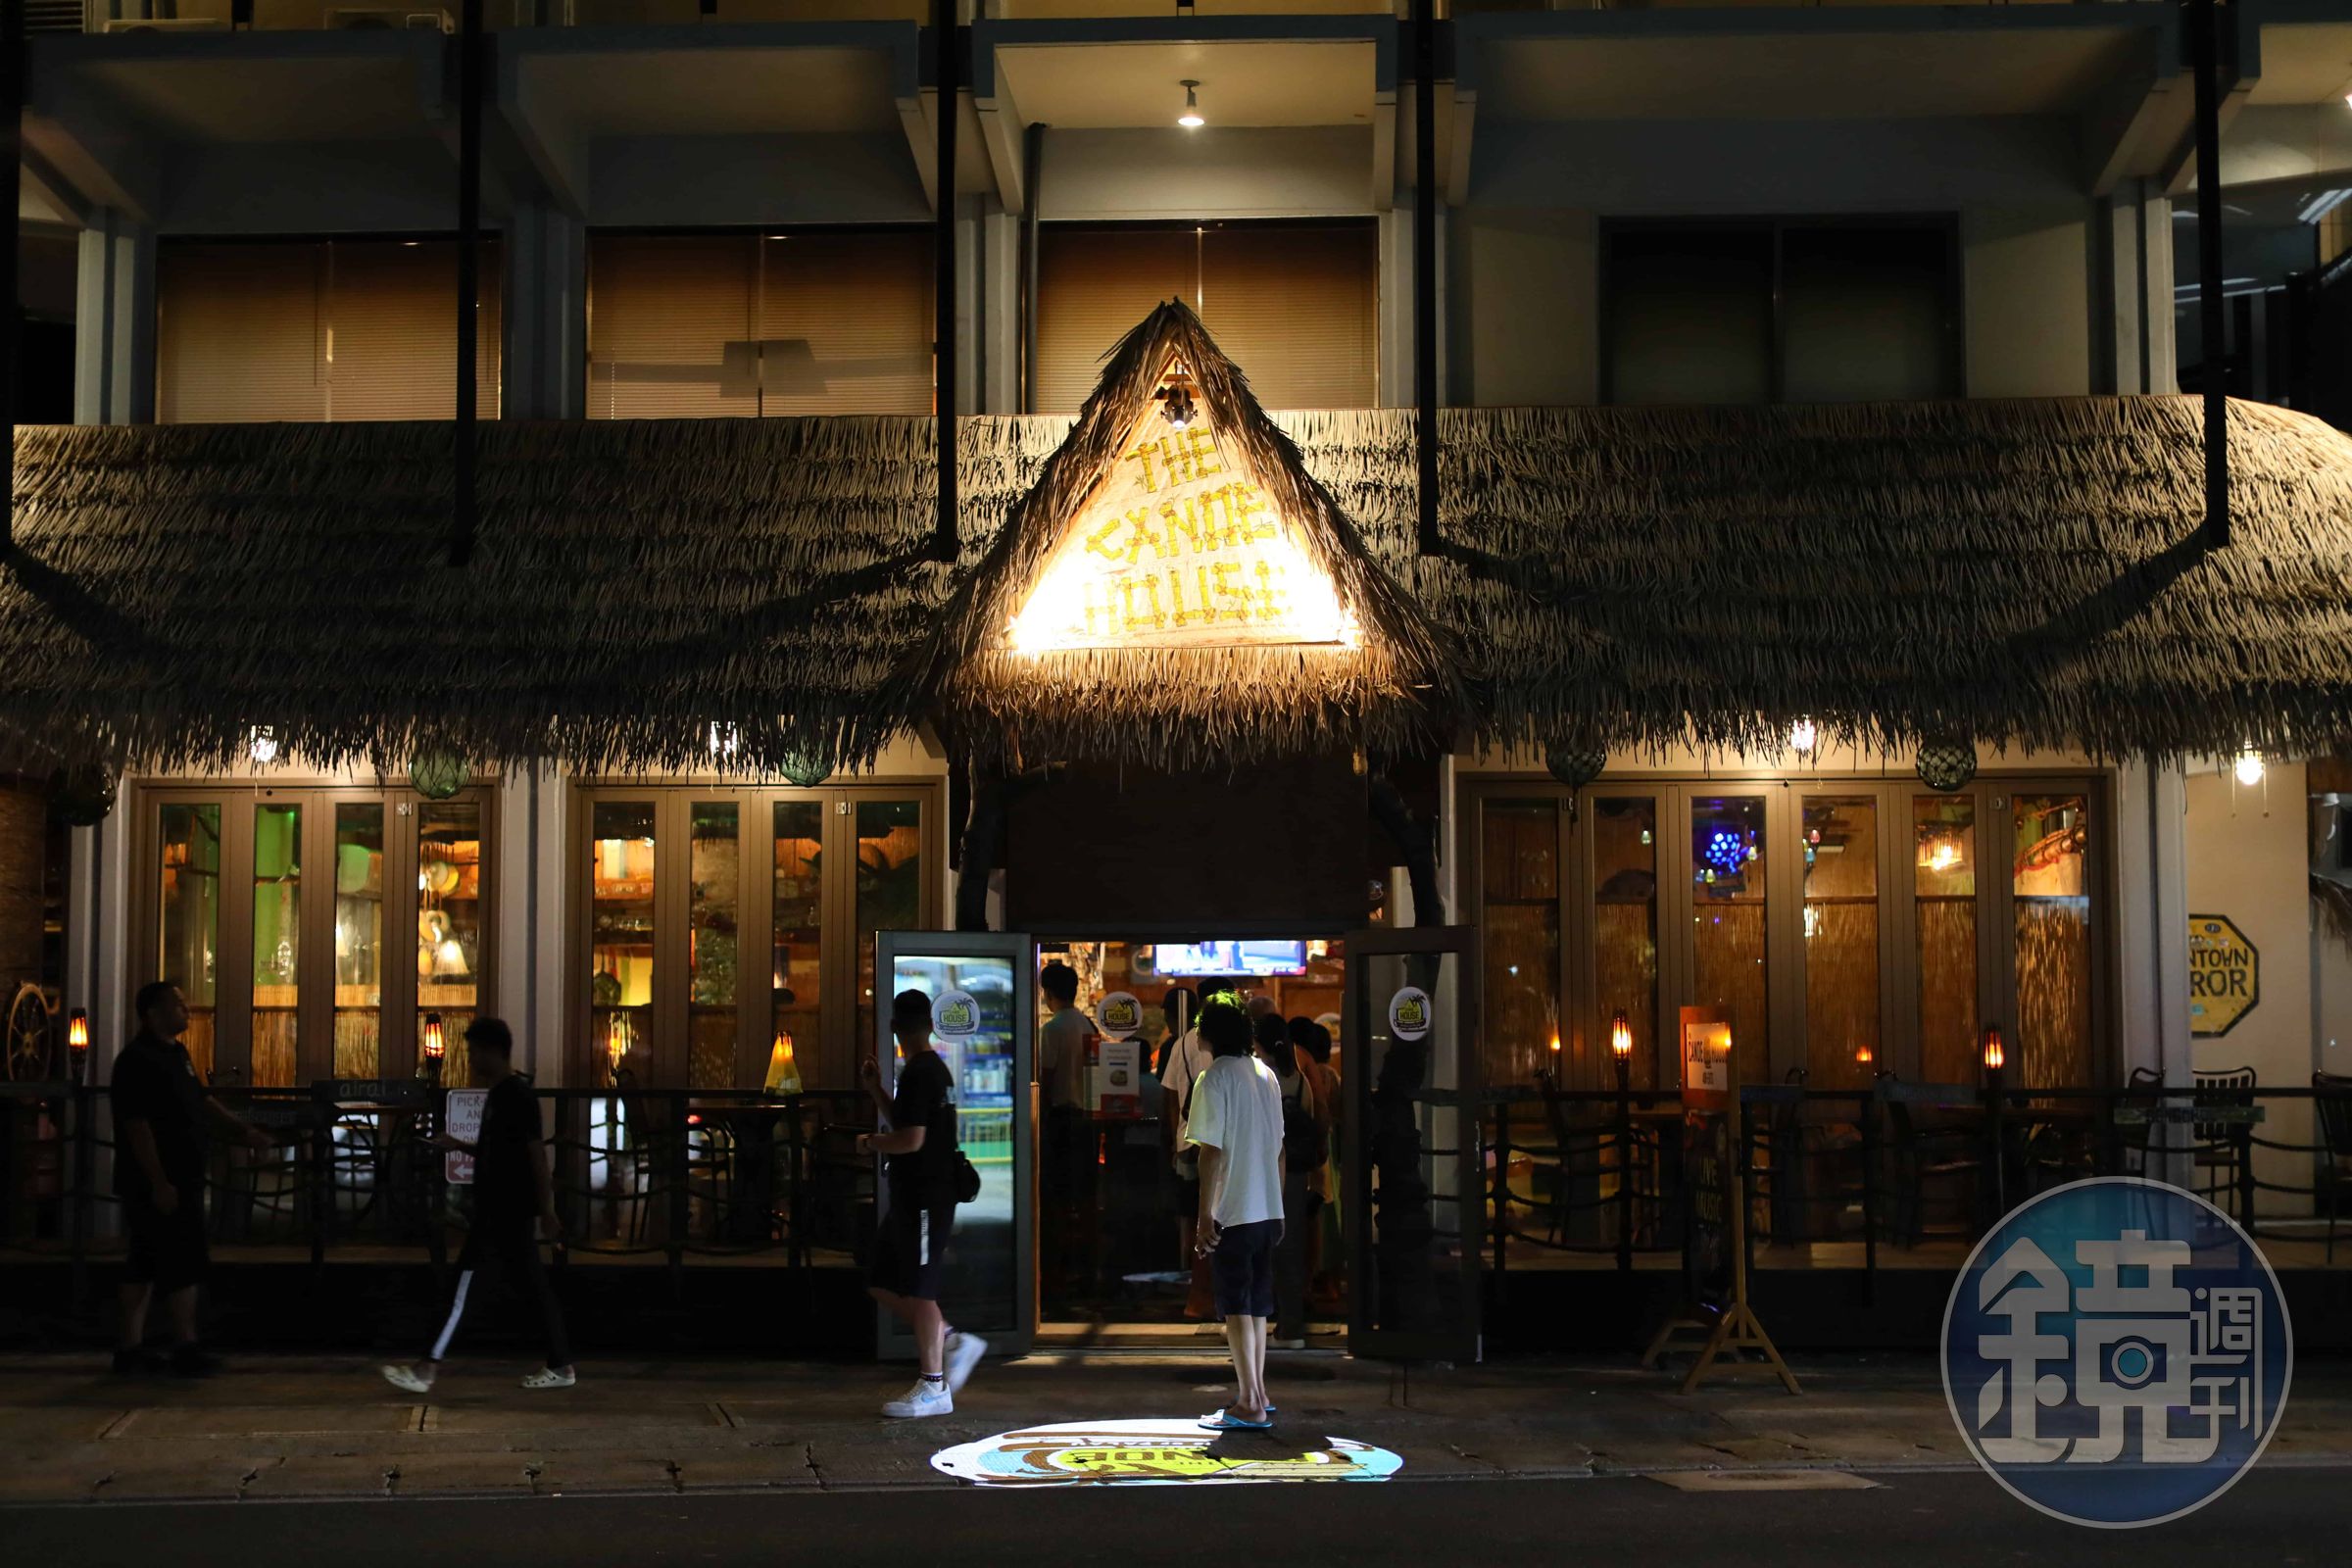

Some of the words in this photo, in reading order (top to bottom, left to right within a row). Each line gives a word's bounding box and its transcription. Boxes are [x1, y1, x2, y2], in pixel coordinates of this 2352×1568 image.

[1125, 427, 1221, 493] THE
[1085, 481, 1276, 564] CANOE
[1084, 561, 1294, 636] HOUSE
[943, 1013, 967, 1023] HOUSE
[1399, 1010, 1420, 1020] HOUSE
